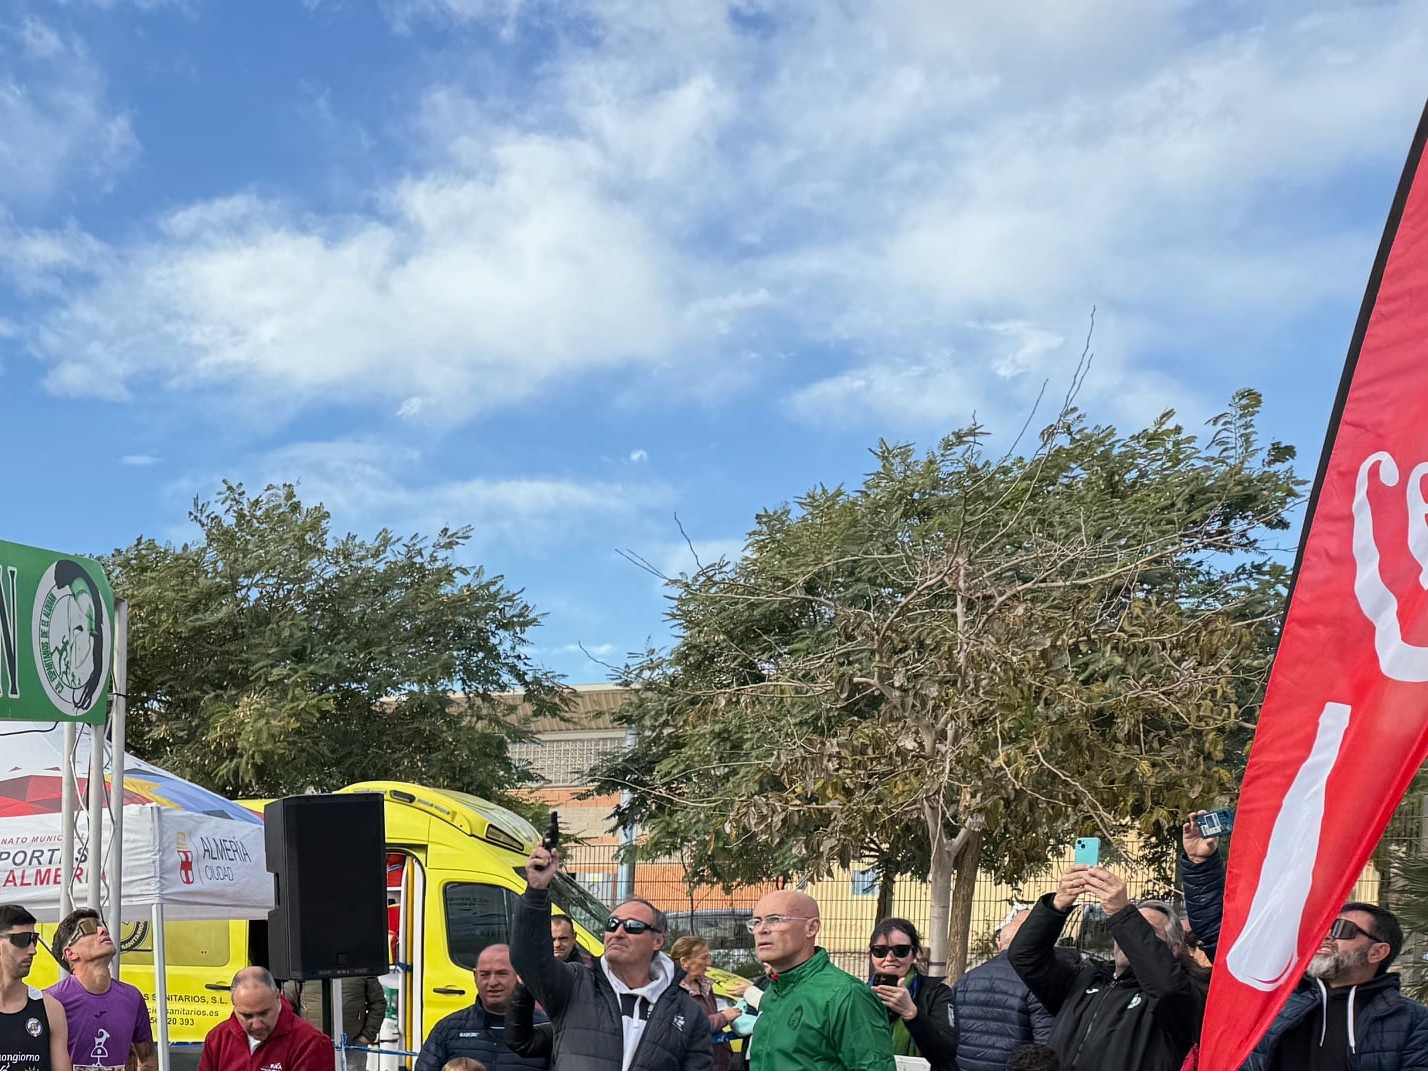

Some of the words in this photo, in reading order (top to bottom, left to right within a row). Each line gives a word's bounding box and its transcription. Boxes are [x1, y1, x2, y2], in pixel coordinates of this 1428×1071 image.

[200, 835, 252, 863] ALMERÍA
[204, 865, 234, 881] CIUDAD
[211, 996, 228, 1005] S.L.
[179, 1018, 195, 1026] 393
